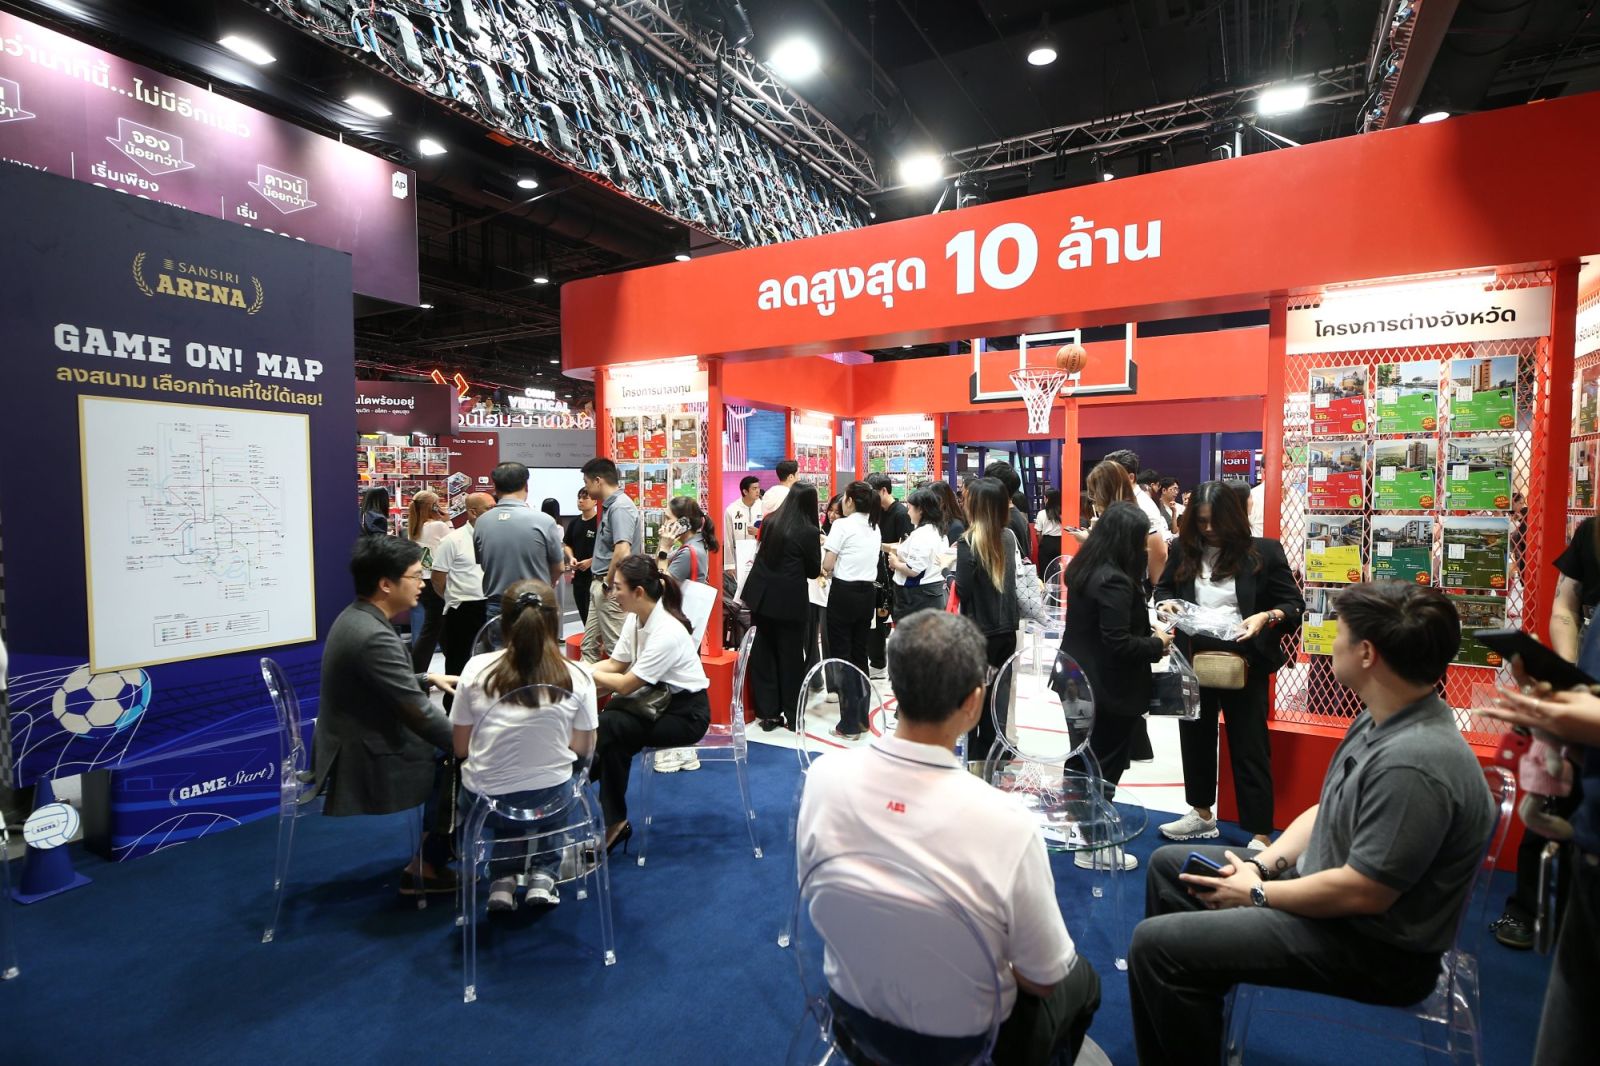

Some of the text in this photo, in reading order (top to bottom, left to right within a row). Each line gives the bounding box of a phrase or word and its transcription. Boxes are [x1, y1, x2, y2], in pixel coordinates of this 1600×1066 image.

[0, 33, 250, 138] ว่านาทีนี้...ไม่มีอีกแล้ว
[132, 130, 170, 152] จอง
[91, 160, 160, 192] เริ่มเพียง
[265, 173, 303, 195] ดาวน์
[394, 179, 406, 190] AP
[236, 202, 258, 220] เริ่ม
[178, 262, 240, 284] SANSIRI
[757, 215, 1162, 316] ลดสูงสุด 10 ล้าน
[157, 274, 247, 309] ARENA
[1315, 306, 1517, 338] โครงการต่างจังหวัด
[54, 323, 324, 382] GAME ON! MAP
[56, 366, 323, 406] ลงสนาม เลือกทำเลที่ใช่ได้เลย!
[734, 522, 743, 530] 10
[179, 765, 267, 800] GAME Start
